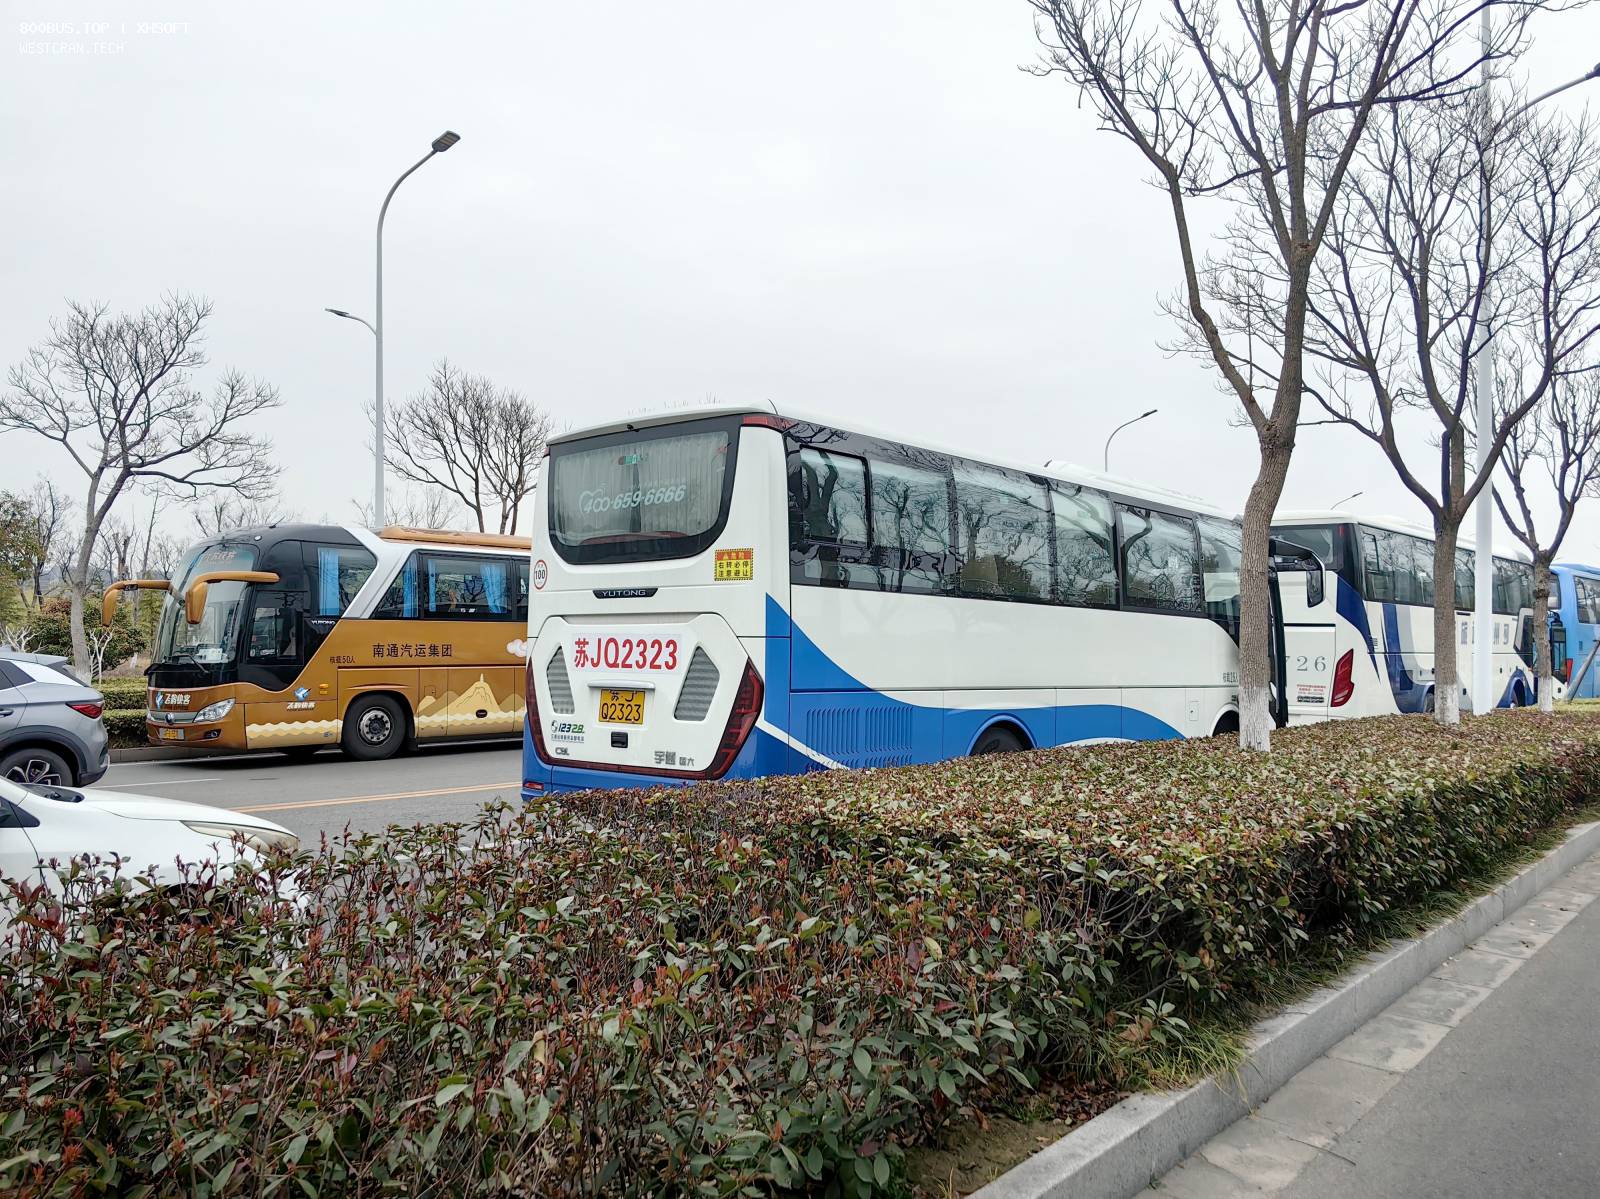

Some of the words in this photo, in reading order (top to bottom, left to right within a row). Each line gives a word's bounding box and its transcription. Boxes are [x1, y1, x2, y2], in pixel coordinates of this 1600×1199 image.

[535, 569, 546, 580] 100
[372, 643, 452, 658] 南通汽运集团
[574, 637, 678, 670] 苏JQ2323
[601, 702, 642, 721] Q2323
[558, 723, 585, 733] 12328
